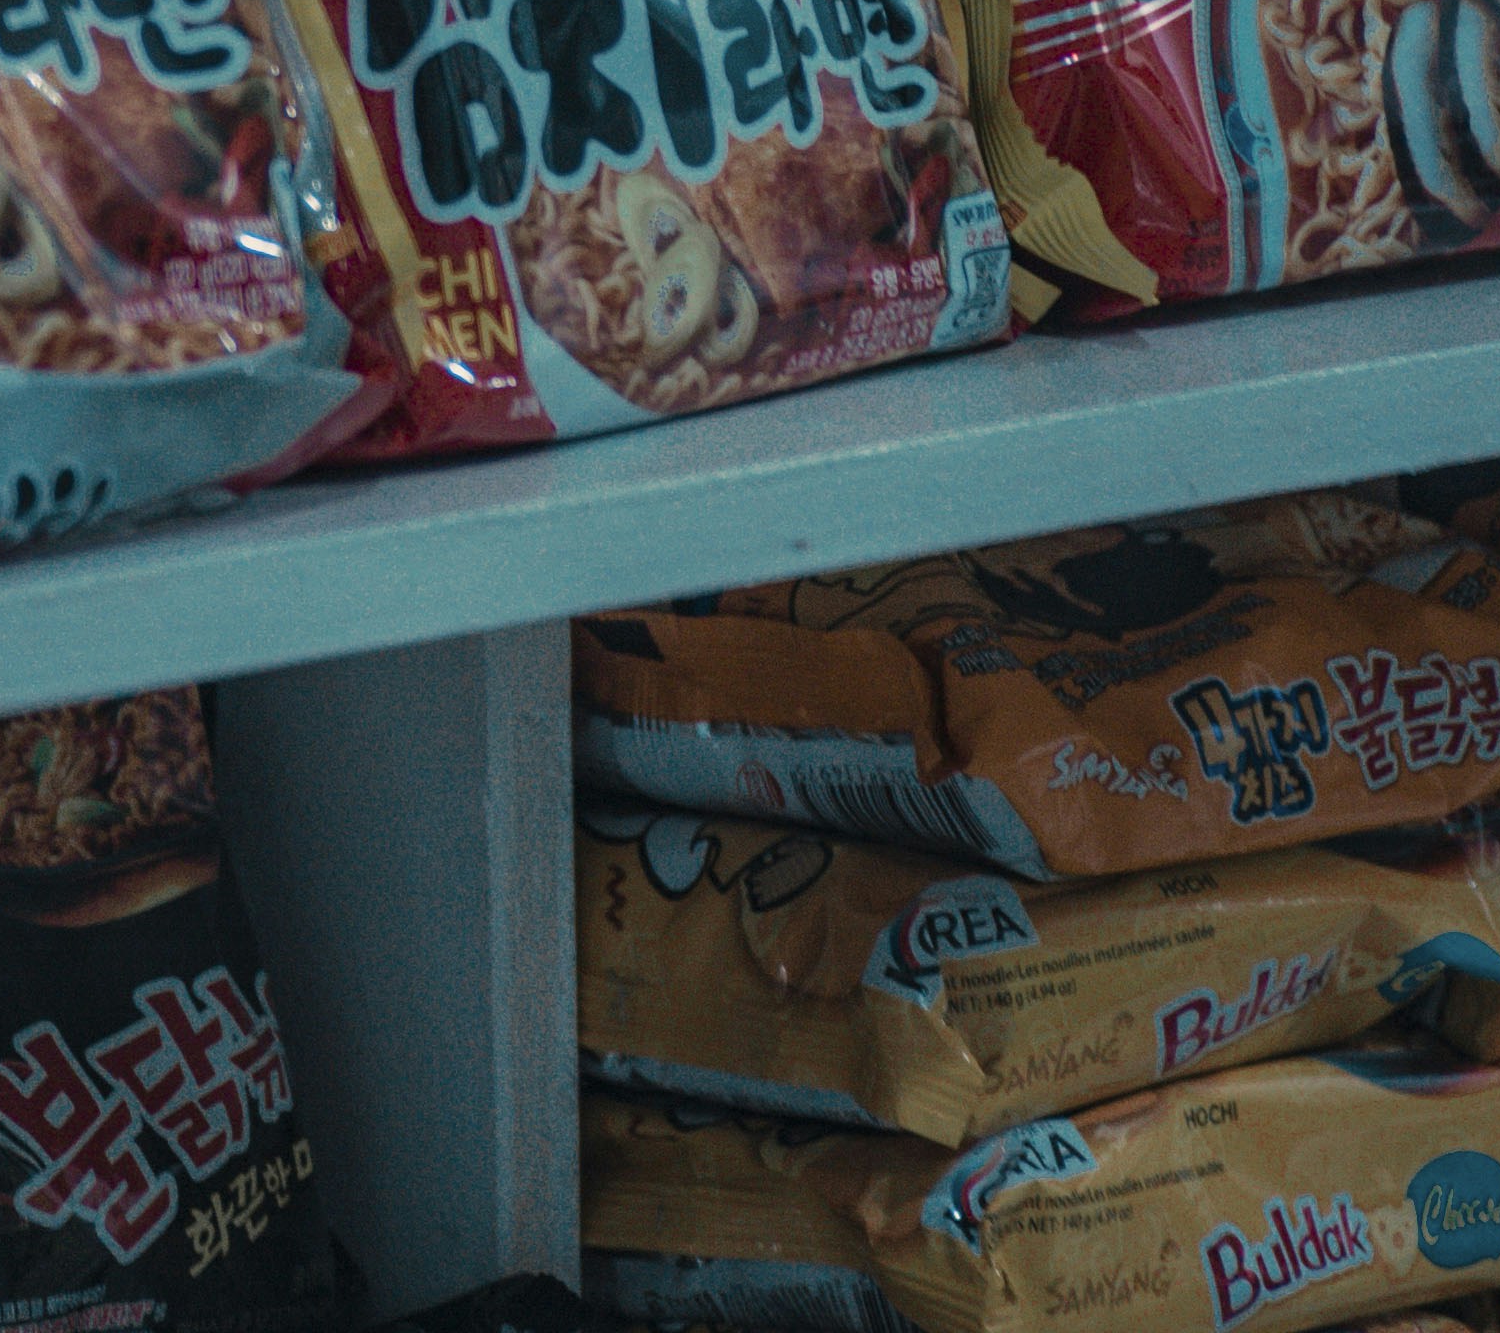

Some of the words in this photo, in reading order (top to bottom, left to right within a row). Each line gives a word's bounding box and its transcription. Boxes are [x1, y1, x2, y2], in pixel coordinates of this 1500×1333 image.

[415, 245, 498, 312] CHI
[418, 310, 518, 368] MEN
[1228, 758, 1317, 823] 치즈
[186, 1165, 292, 1278] 화끈한
[1202, 1190, 1372, 1333] Buldak
